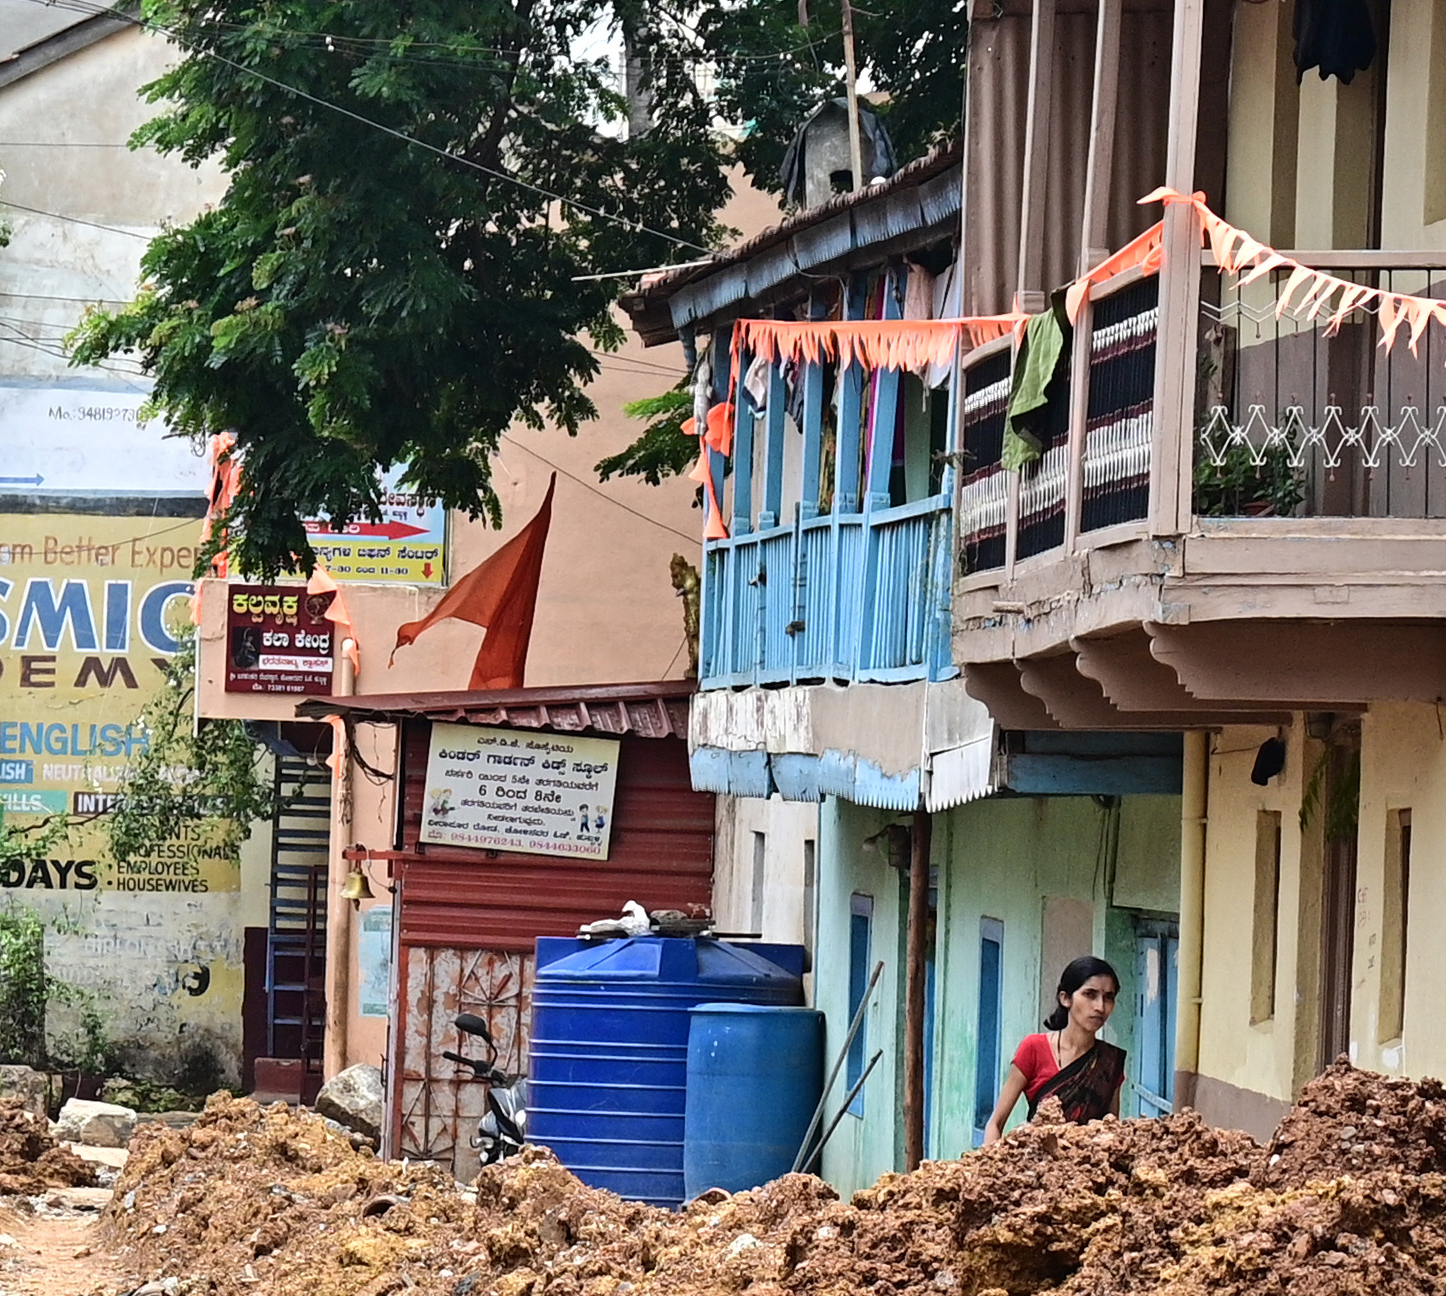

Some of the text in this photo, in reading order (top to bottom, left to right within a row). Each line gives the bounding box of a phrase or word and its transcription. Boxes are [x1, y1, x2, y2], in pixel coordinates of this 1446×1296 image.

[44, 535, 120, 568] Better
[233, 593, 298, 626] ಕಲ್ಪವೃಕ್ಷ
[263, 629, 330, 655] ಕಲಾ ಕೇಂದ್ರ
[0, 721, 151, 757] ENGLISH
[439, 748, 481, 762] ಕಿಂಡರ್
[487, 752, 535, 768] ಗಾರ್ಡನ್
[572, 761, 608, 779] ಸ್ಕೂಲ್
[479, 785, 562, 803] 6 ರಿಂದ 8ನೇ
[117, 861, 200, 877] EMPLOYEES
[117, 877, 208, 893] HOUSEWIVES
